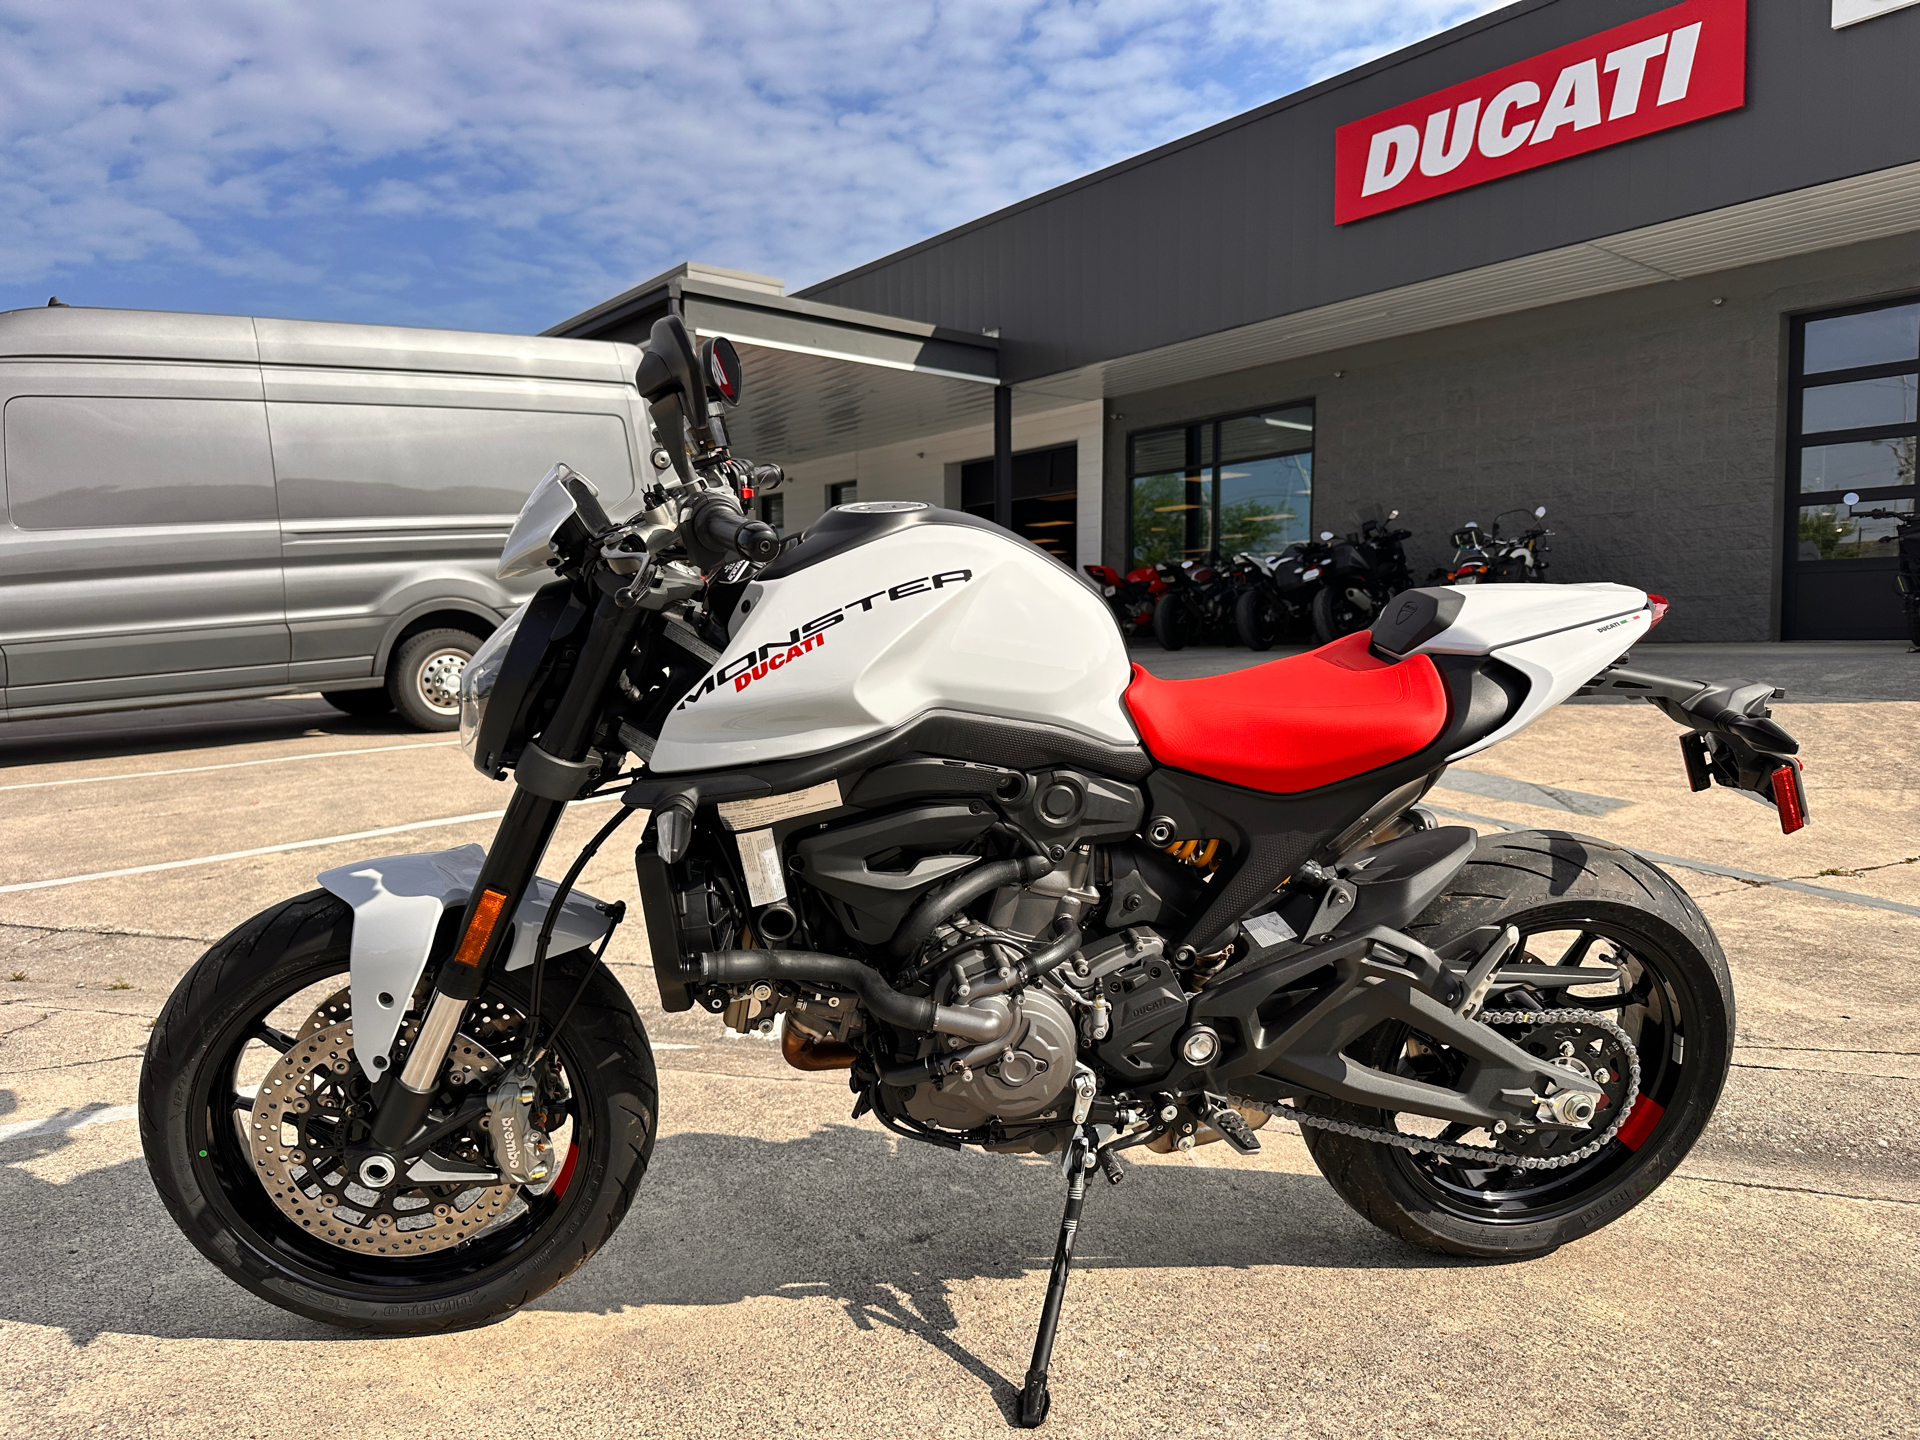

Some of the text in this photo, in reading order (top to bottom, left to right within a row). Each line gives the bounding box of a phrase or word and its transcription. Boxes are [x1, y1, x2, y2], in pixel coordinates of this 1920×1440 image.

[1360, 20, 1703, 198] DUCATI
[676, 569, 972, 711] MONSTER
[1597, 621, 1621, 634] DUCATI
[734, 632, 825, 693] DUCATI
[1132, 997, 1167, 1018] DUCATI
[501, 1117, 520, 1169] brembo
[277, 1279, 473, 1317] DIABLO ROSSO
